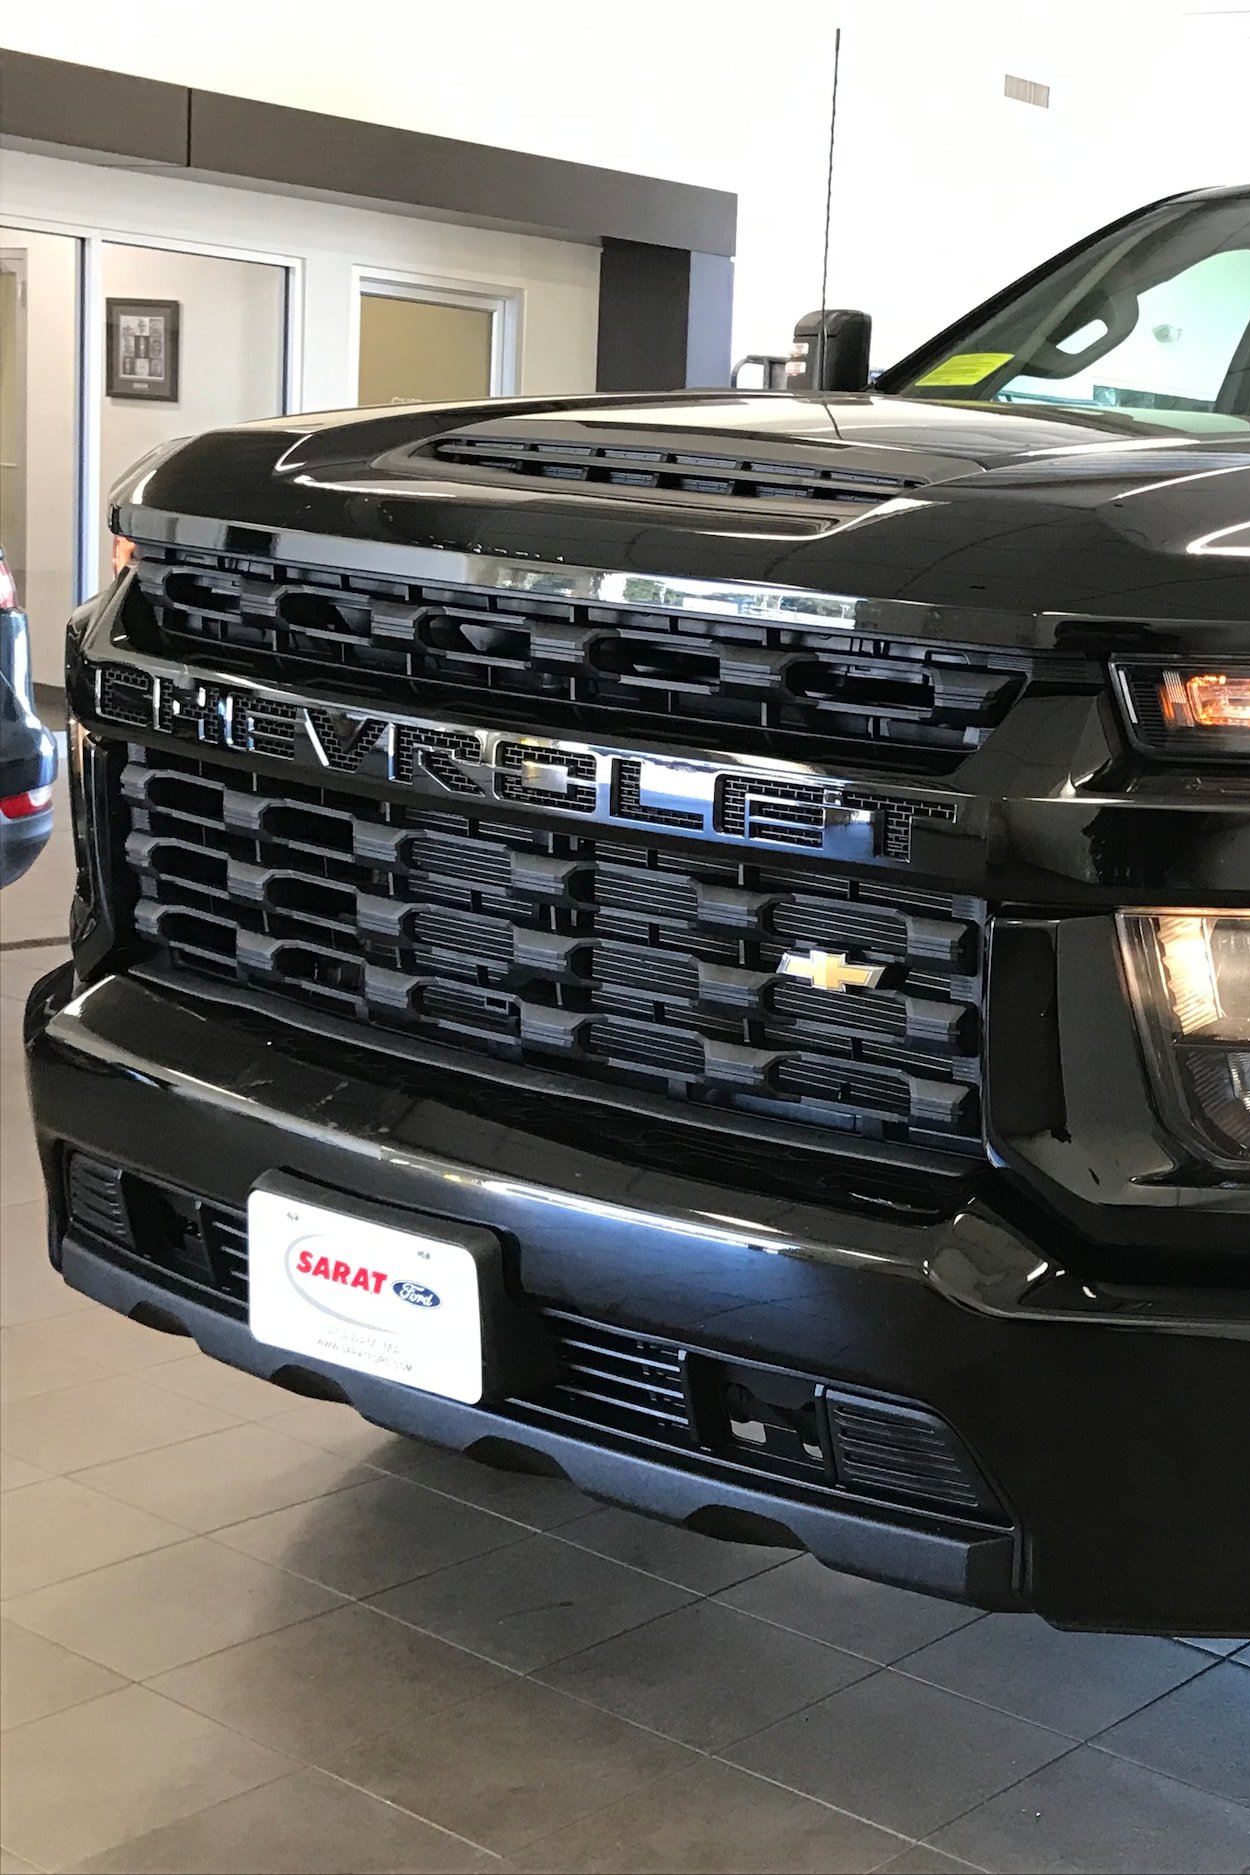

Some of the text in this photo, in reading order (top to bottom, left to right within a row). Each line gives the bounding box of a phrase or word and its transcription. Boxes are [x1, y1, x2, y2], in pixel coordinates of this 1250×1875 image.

[95, 665, 957, 864] CHEVROLET
[296, 1250, 435, 1306] SARAT Ford
